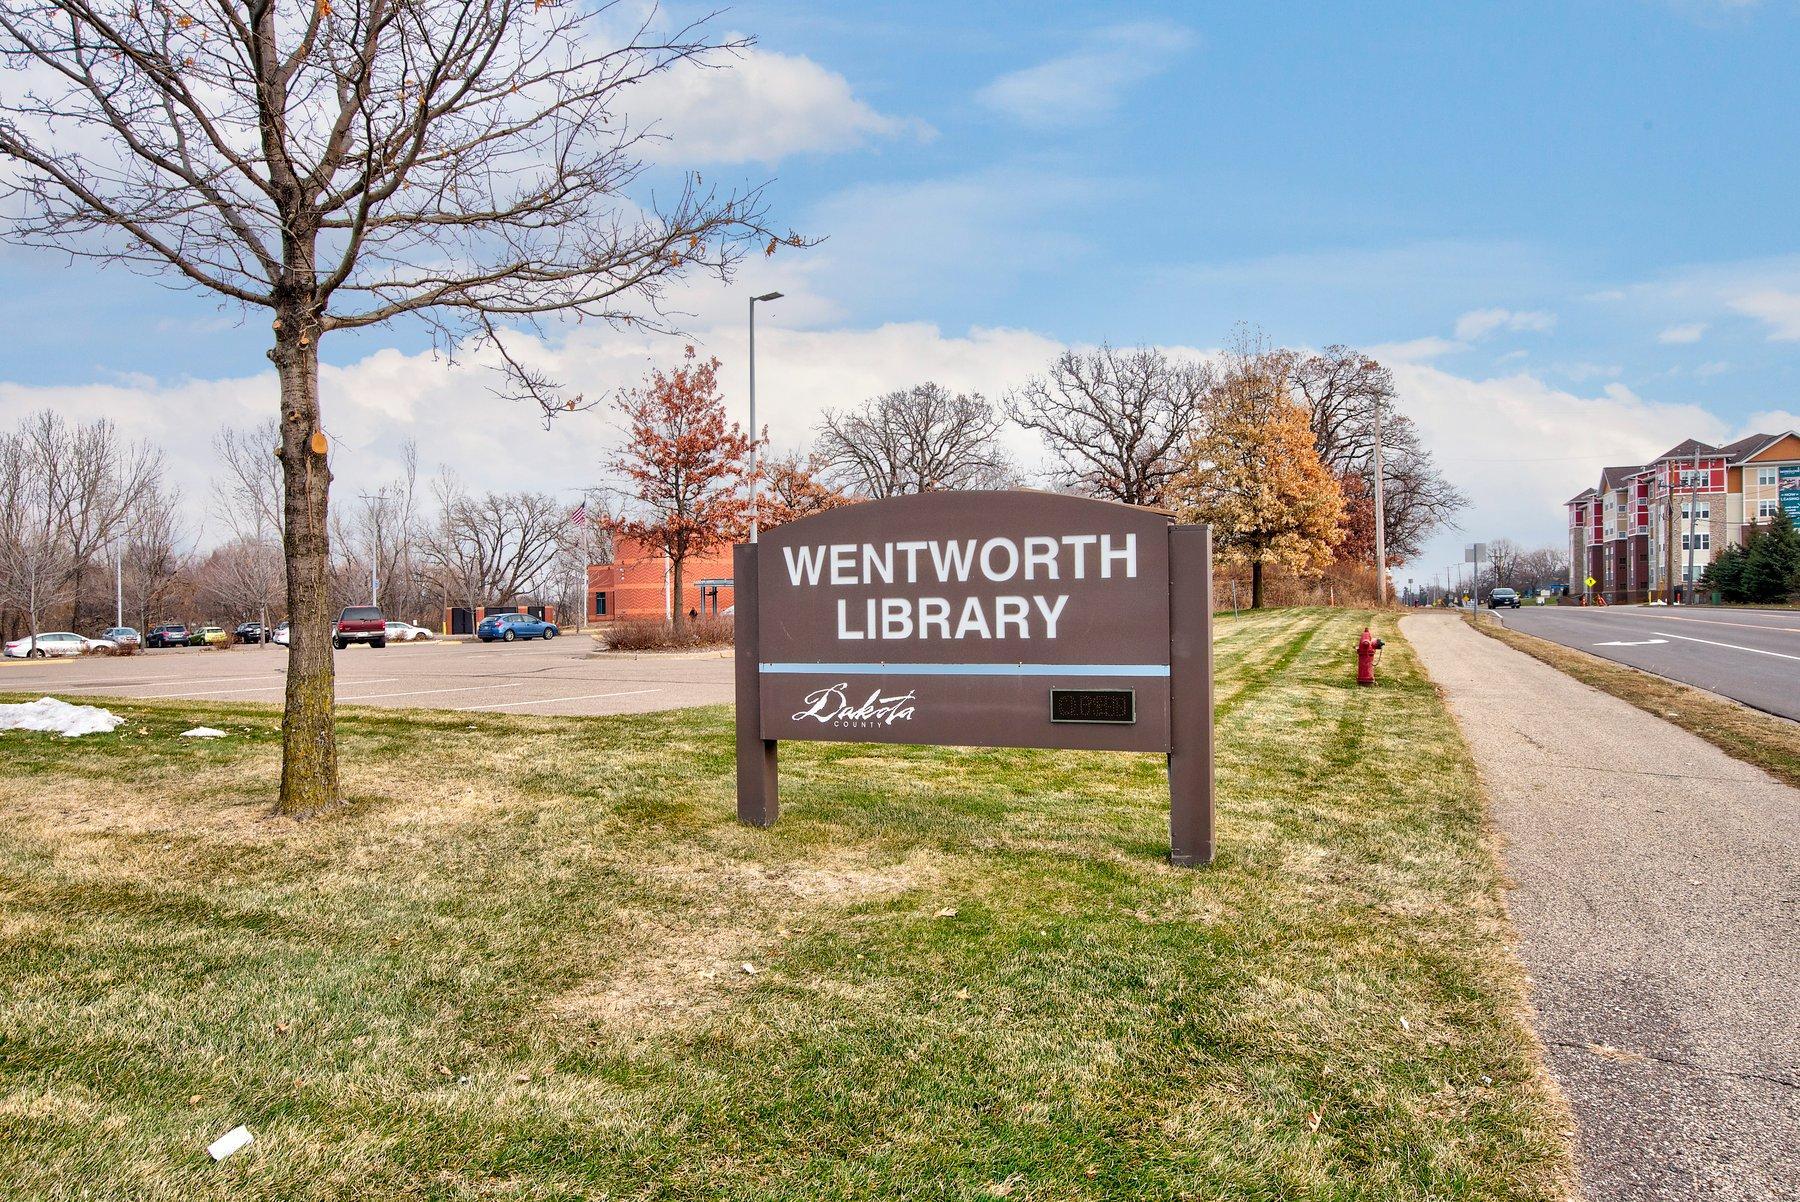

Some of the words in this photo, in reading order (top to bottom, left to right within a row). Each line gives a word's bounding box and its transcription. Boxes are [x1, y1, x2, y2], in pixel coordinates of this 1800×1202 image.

[783, 533, 1138, 587] WENTWORTH
[837, 594, 1069, 640] LIBRARY
[791, 682, 916, 726] Dakota
[833, 720, 882, 729] COUNTY
